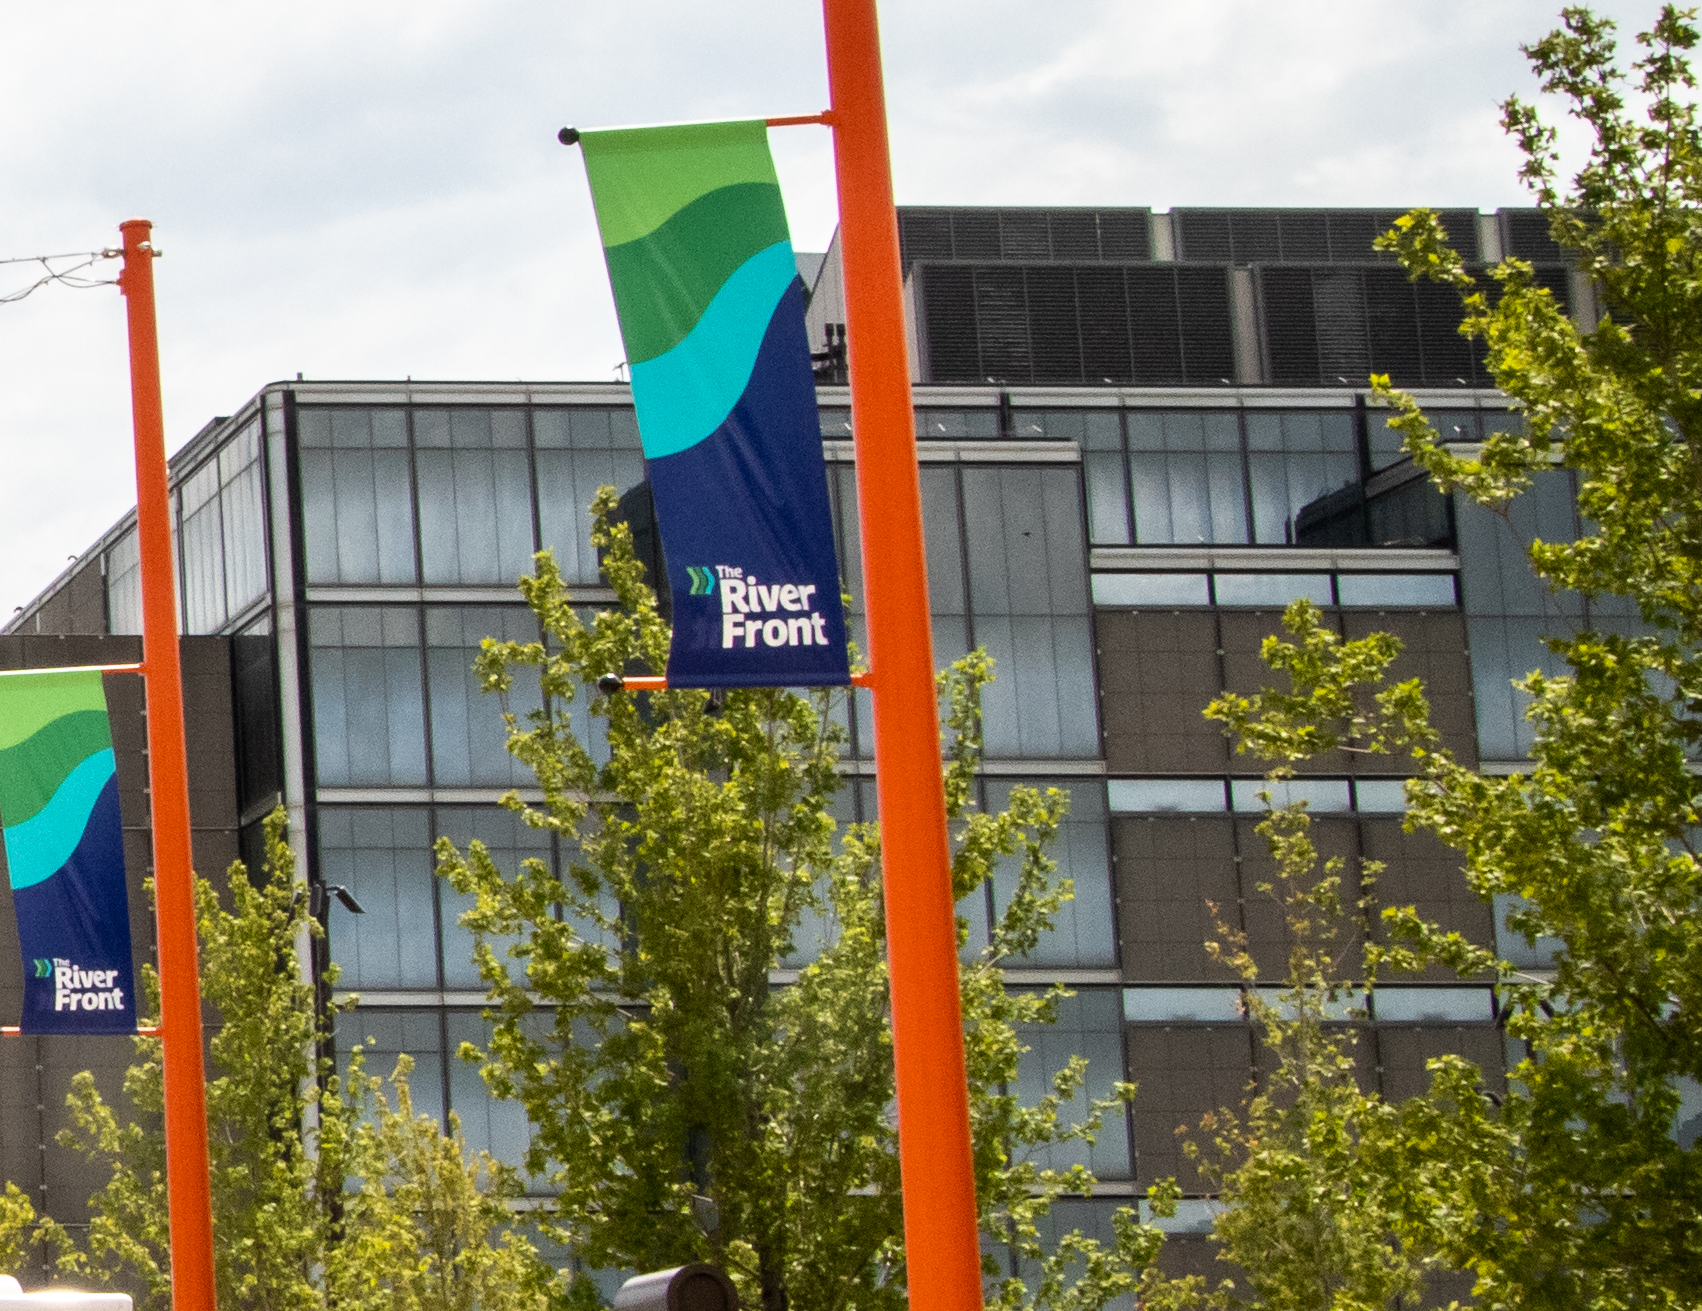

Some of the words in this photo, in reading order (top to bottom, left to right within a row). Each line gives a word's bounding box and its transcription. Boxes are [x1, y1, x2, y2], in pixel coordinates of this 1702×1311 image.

[715, 565, 743, 578] The
[720, 576, 815, 613] River
[722, 612, 829, 649] Front
[53, 958, 70, 967] The
[55, 965, 118, 989] River
[55, 987, 125, 1011] Front
